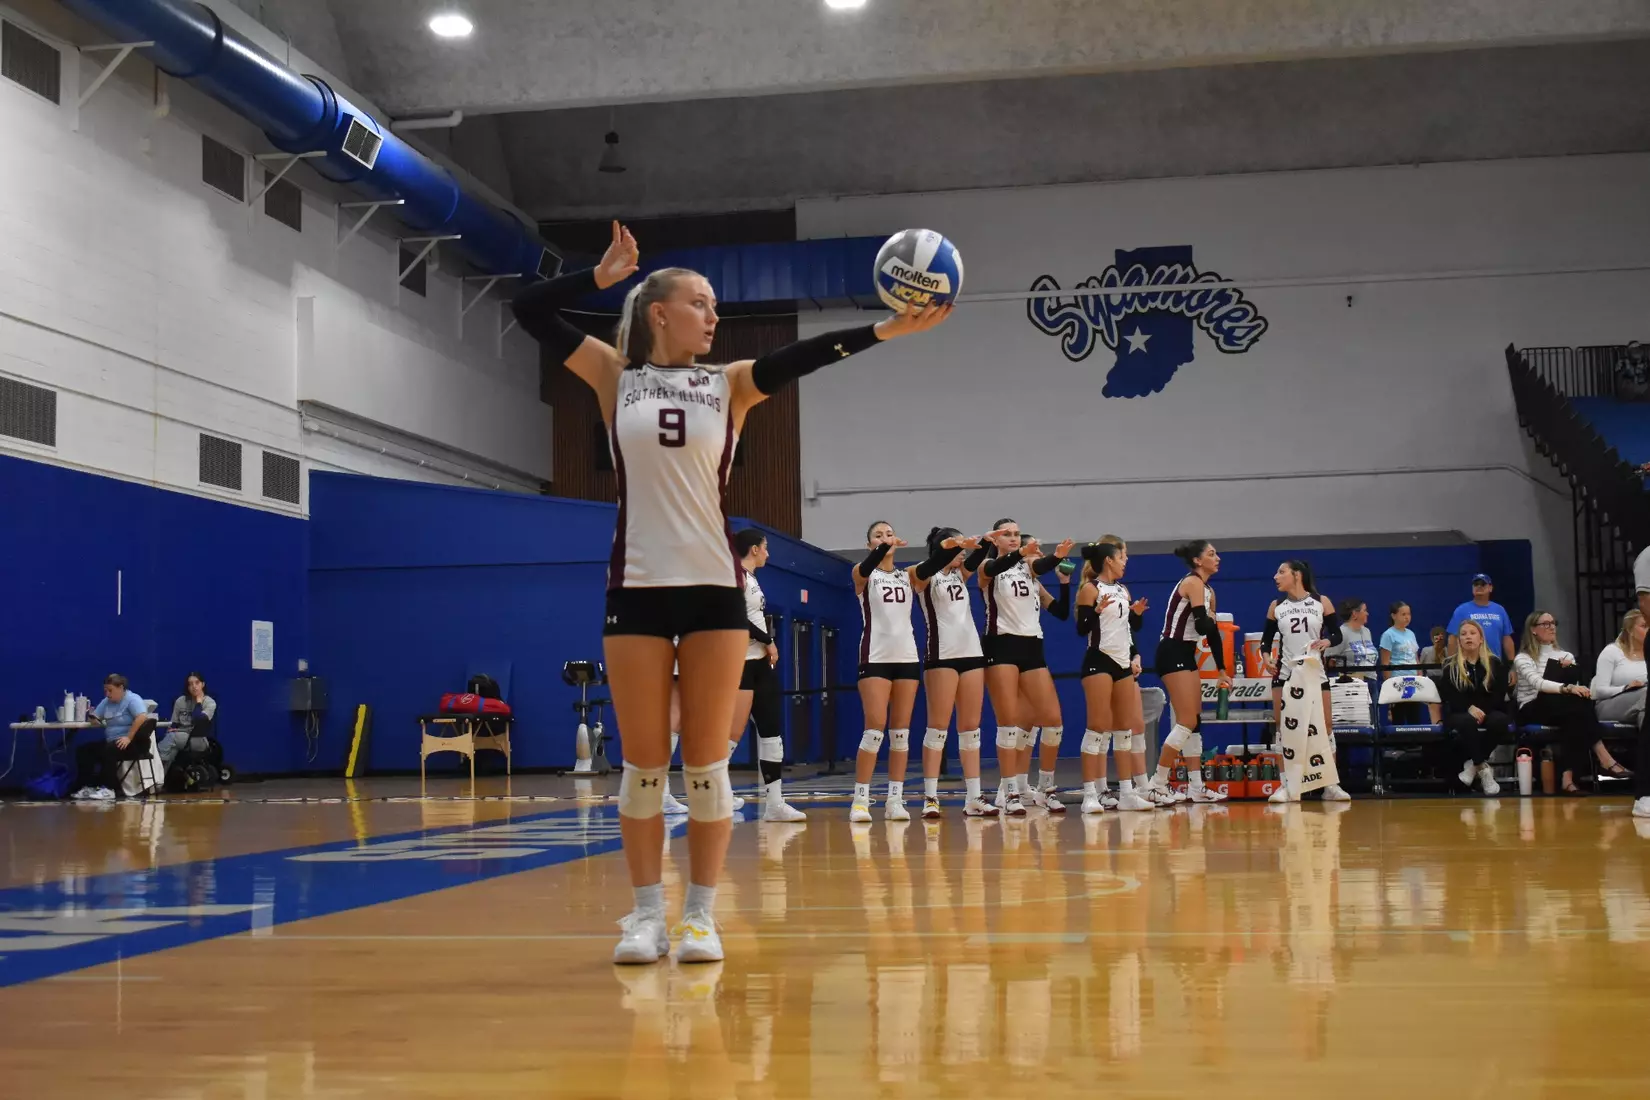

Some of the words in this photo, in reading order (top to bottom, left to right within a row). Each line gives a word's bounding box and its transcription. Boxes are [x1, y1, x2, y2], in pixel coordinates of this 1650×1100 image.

[891, 265, 940, 290] molten
[658, 408, 686, 448] 9
[882, 586, 906, 603] 20
[946, 584, 965, 602] 12
[1010, 580, 1030, 597] 15
[1117, 602, 1123, 618] 1
[1289, 616, 1309, 633] 21
[1201, 682, 1266, 698] Garade
[1302, 772, 1322, 783] ADE
